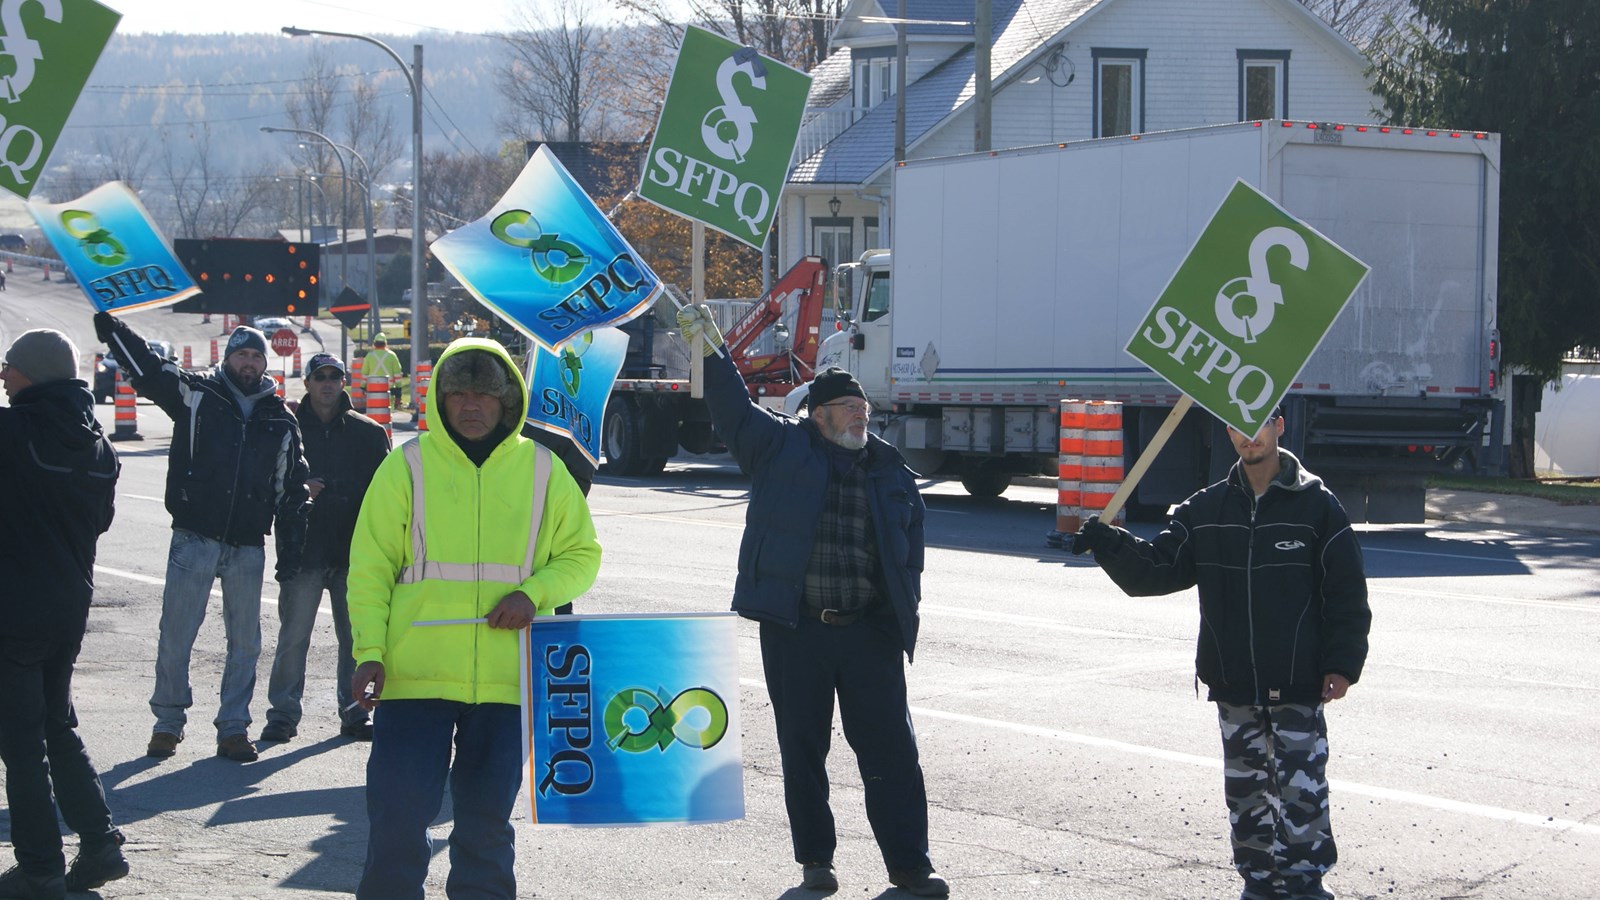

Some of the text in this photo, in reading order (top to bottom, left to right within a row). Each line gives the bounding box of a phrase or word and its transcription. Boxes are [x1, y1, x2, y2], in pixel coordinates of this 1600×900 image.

[649, 147, 771, 235] SFPQ
[89, 265, 177, 303] SFPQ
[537, 252, 652, 333] SFPQ
[272, 336, 298, 348] ARRÊT
[1142, 305, 1275, 423] SFPQ
[542, 387, 593, 451] SFPQ
[538, 643, 595, 799] SFPQ
